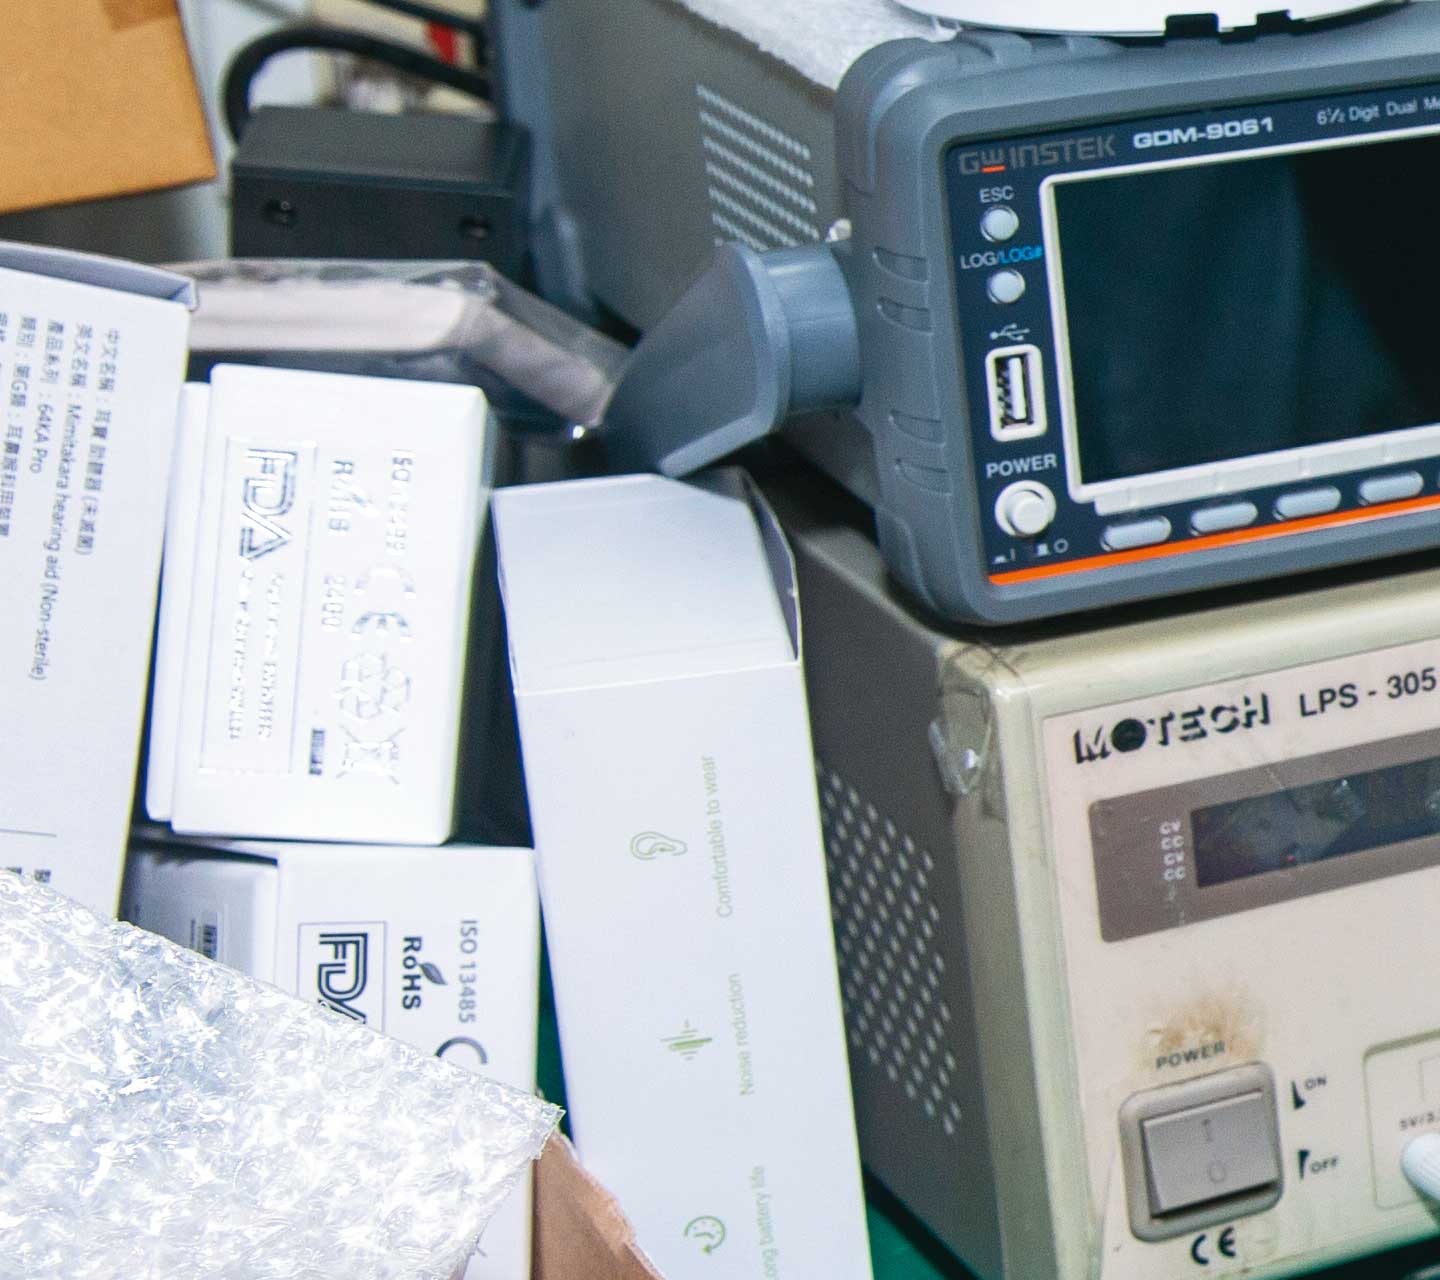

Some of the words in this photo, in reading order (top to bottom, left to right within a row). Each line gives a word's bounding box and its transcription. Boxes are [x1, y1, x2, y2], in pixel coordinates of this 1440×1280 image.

[1133, 116, 1275, 150] GDM-9061
[1348, 102, 1380, 123] Digit
[1386, 98, 1418, 120] Dual
[979, 185, 1015, 204] ESC
[29, 446, 49, 475] Pro
[986, 453, 1058, 480] POWER
[44, 493, 71, 552] hearing
[45, 555, 60, 580] aid
[1299, 683, 1359, 718] LPS
[1386, 667, 1438, 700] 305
[701, 755, 720, 795] wear
[705, 799, 721, 817] to
[1159, 819, 1181, 835] CV
[1161, 835, 1185, 851] CC
[706, 819, 734, 919] Comfortable
[1163, 851, 1186, 867] CV
[1163, 866, 1187, 882] CC
[459, 919, 478, 955] ISO
[402, 935, 422, 1010] RoHS
[457, 960, 477, 1024] 13485
[728, 973, 751, 1048] reduction
[1155, 1040, 1226, 1070] POWER
[739, 1049, 755, 1097] Noise
[1305, 1076, 1328, 1091] ON
[1310, 1155, 1339, 1174] OFF
[755, 1192, 774, 1246] battery
